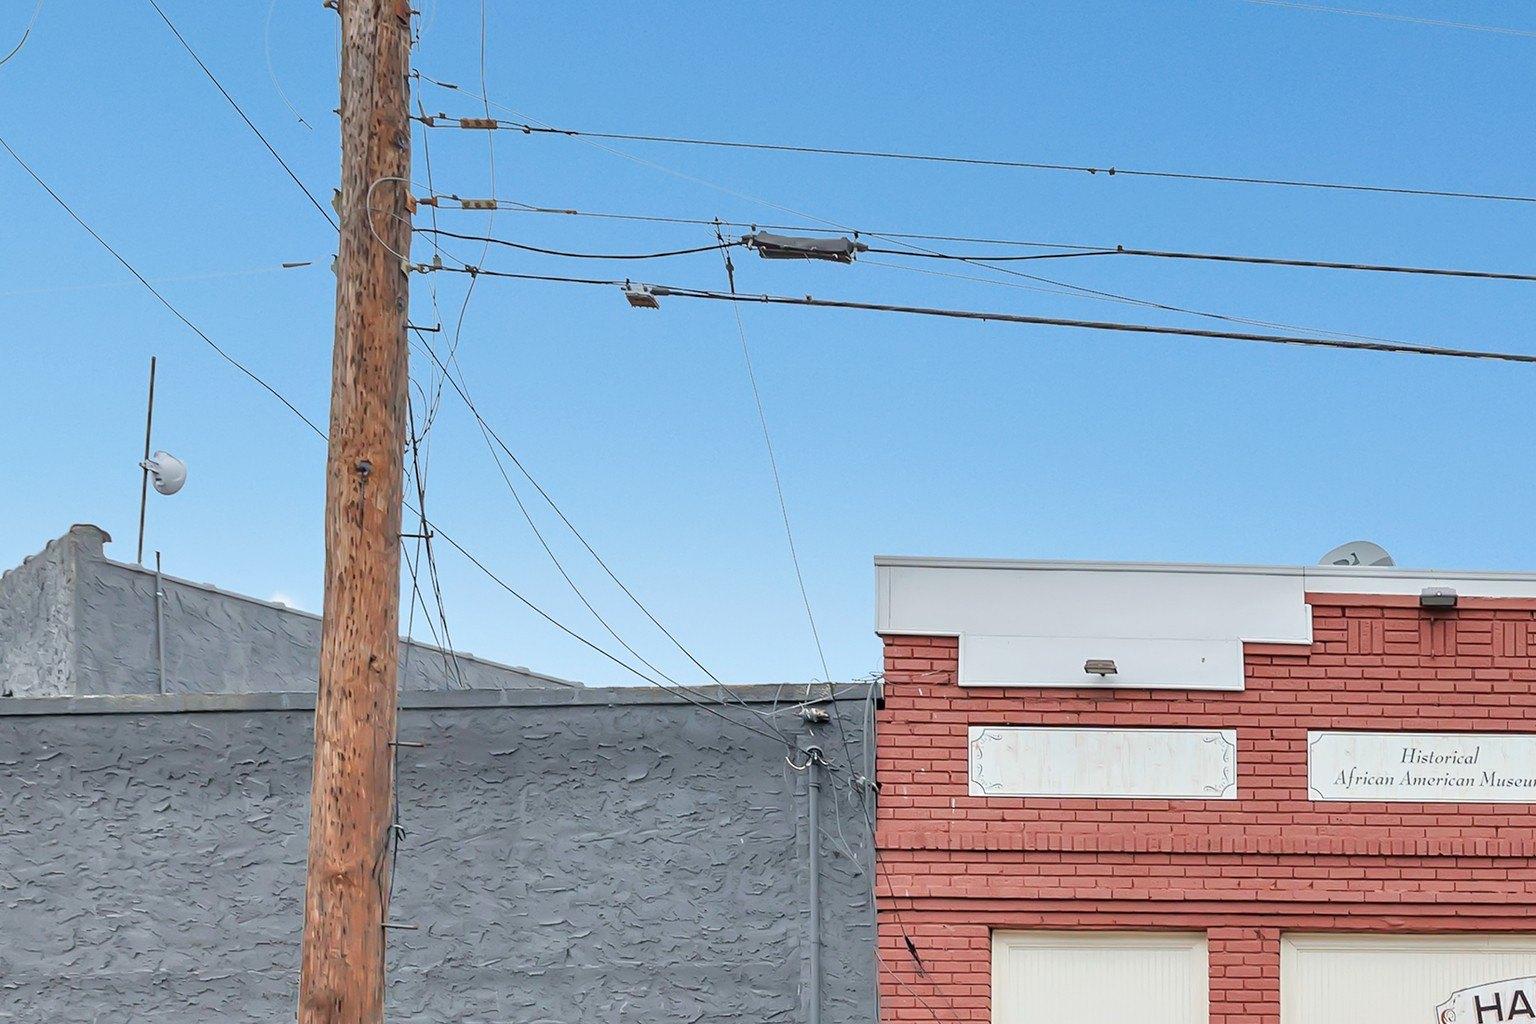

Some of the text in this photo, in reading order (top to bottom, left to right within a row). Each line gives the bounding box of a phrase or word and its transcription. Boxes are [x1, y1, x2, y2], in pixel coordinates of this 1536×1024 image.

[1400, 746, 1480, 765] Historical
[1333, 767, 1395, 789] African
[1399, 770, 1475, 787] American
